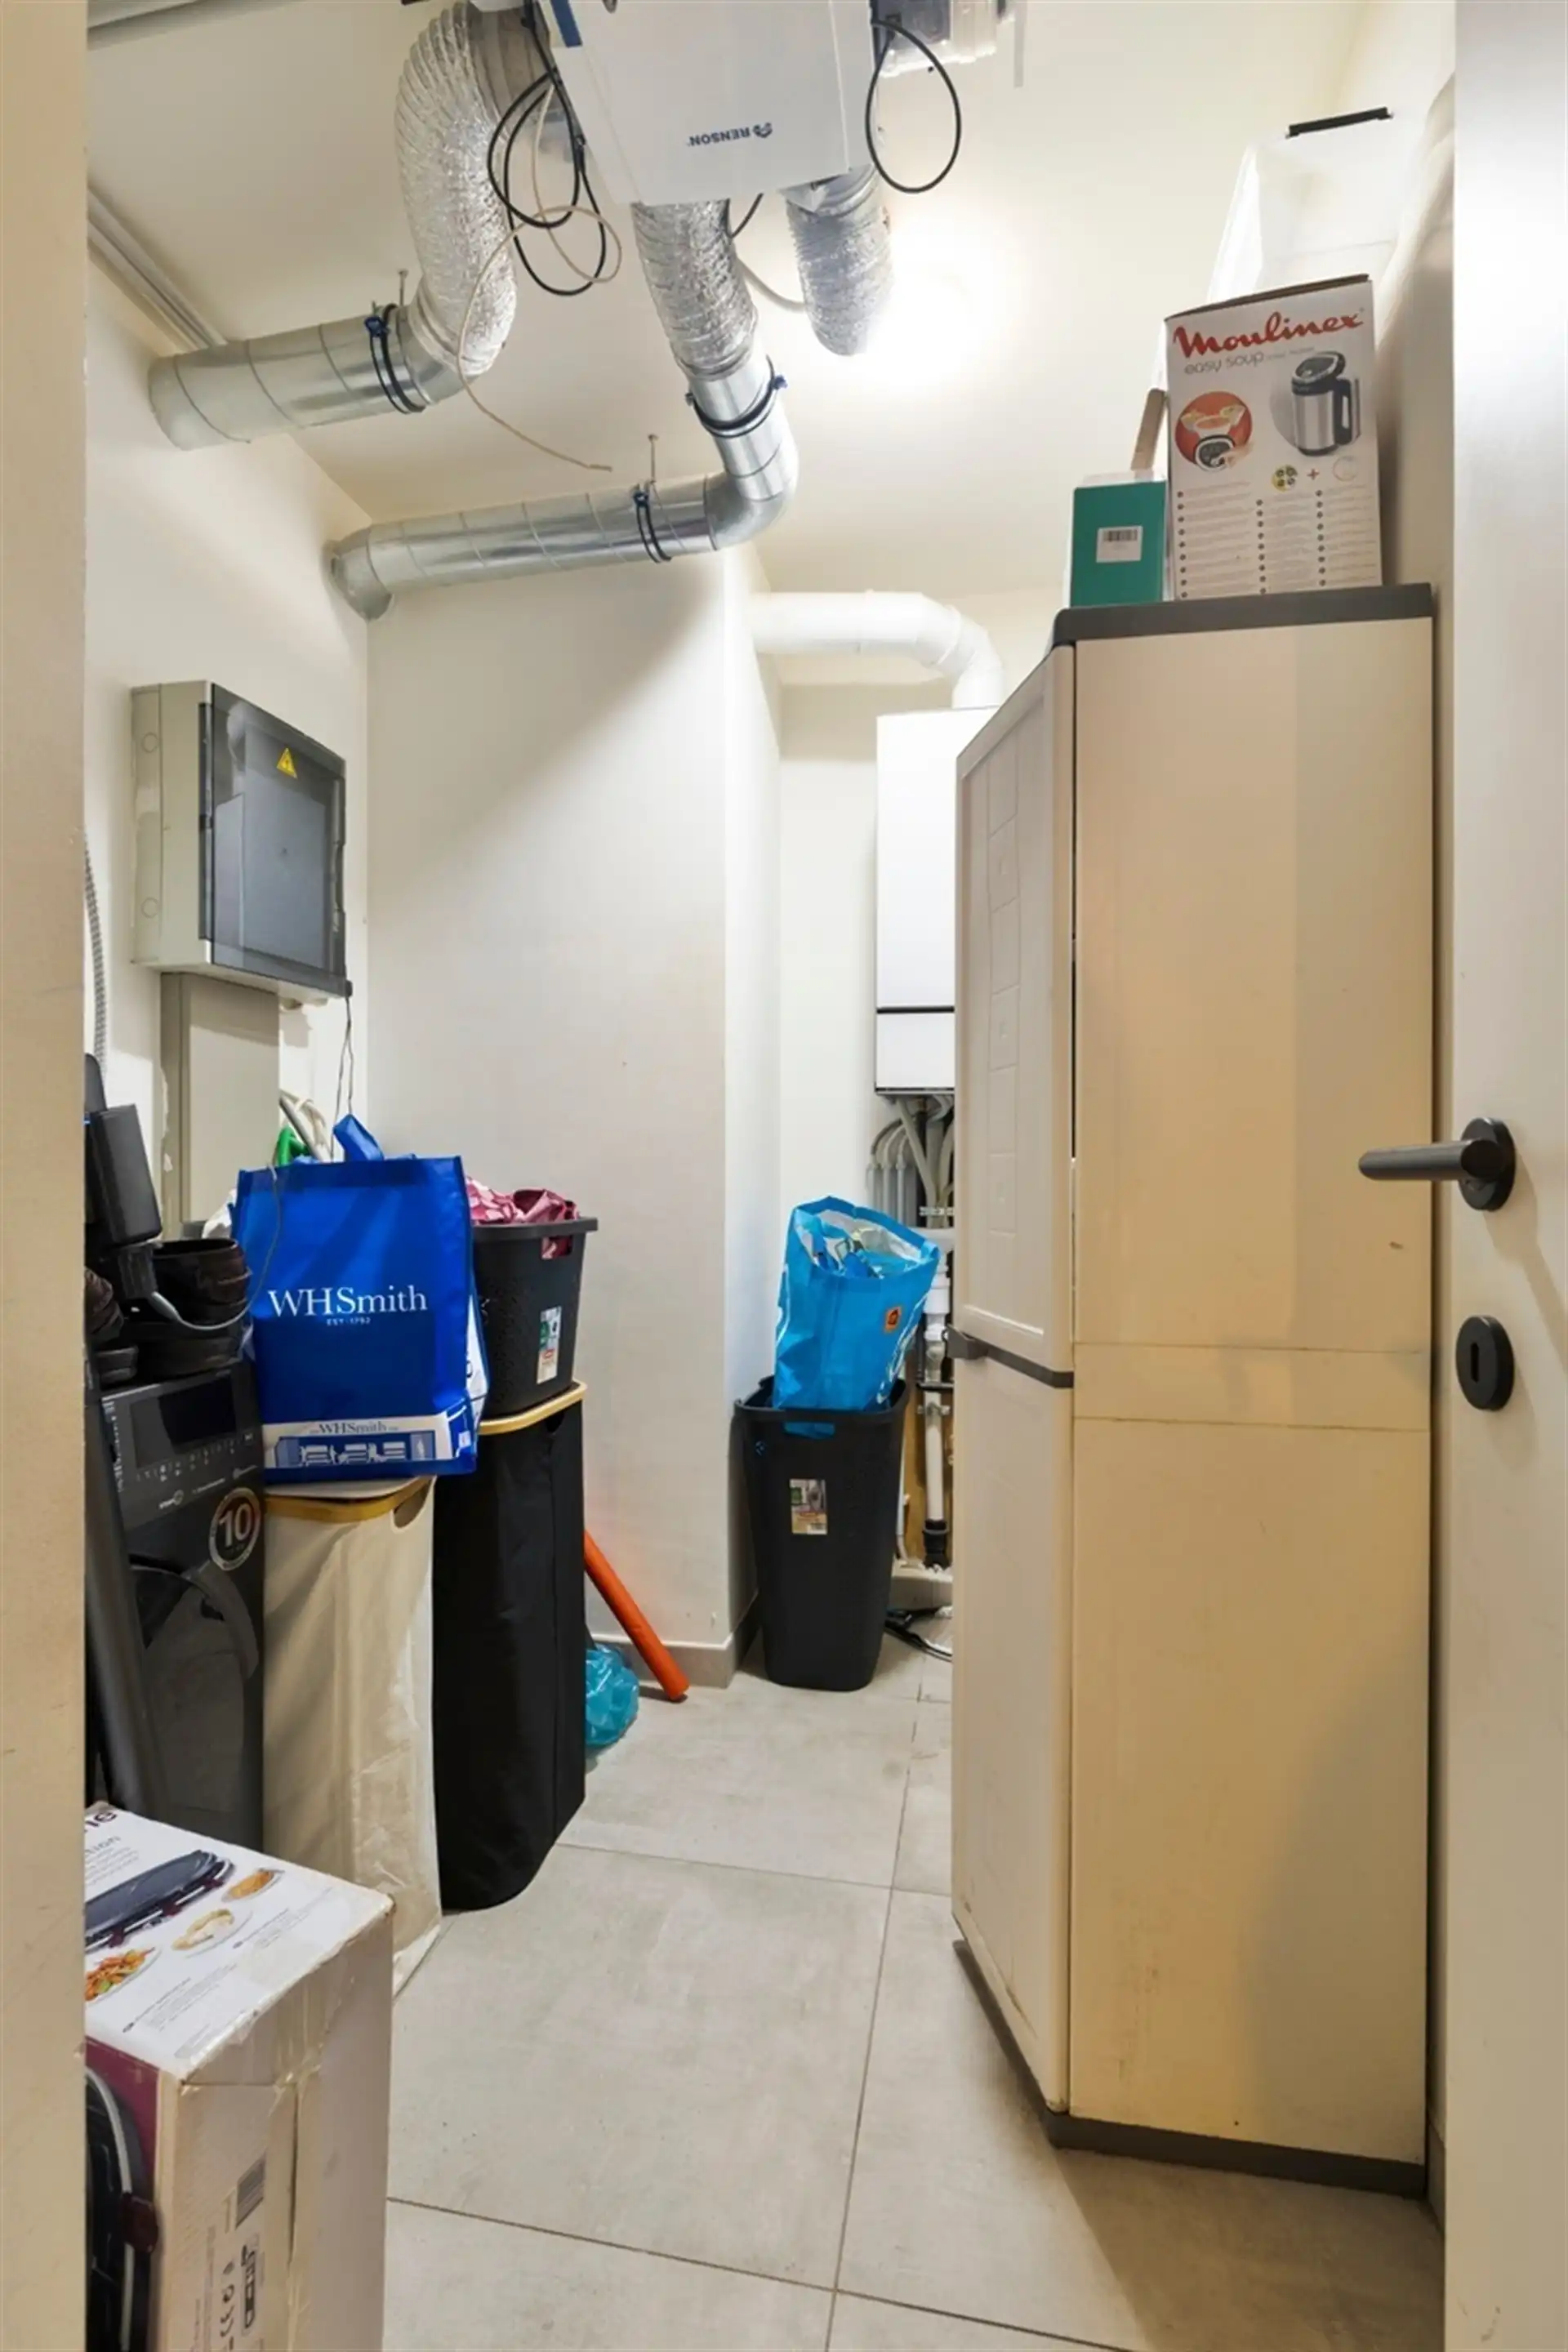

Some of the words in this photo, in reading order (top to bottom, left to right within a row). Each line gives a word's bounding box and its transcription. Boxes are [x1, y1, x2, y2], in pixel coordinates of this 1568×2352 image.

[688, 127, 751, 146] RENSON
[1173, 311, 1364, 358] Moulinex
[1184, 359, 1223, 375] easy
[1226, 350, 1264, 369] soup
[268, 1285, 428, 1317] WHSmith
[318, 1420, 387, 1433] WHSmith
[219, 1503, 252, 1548] 10
